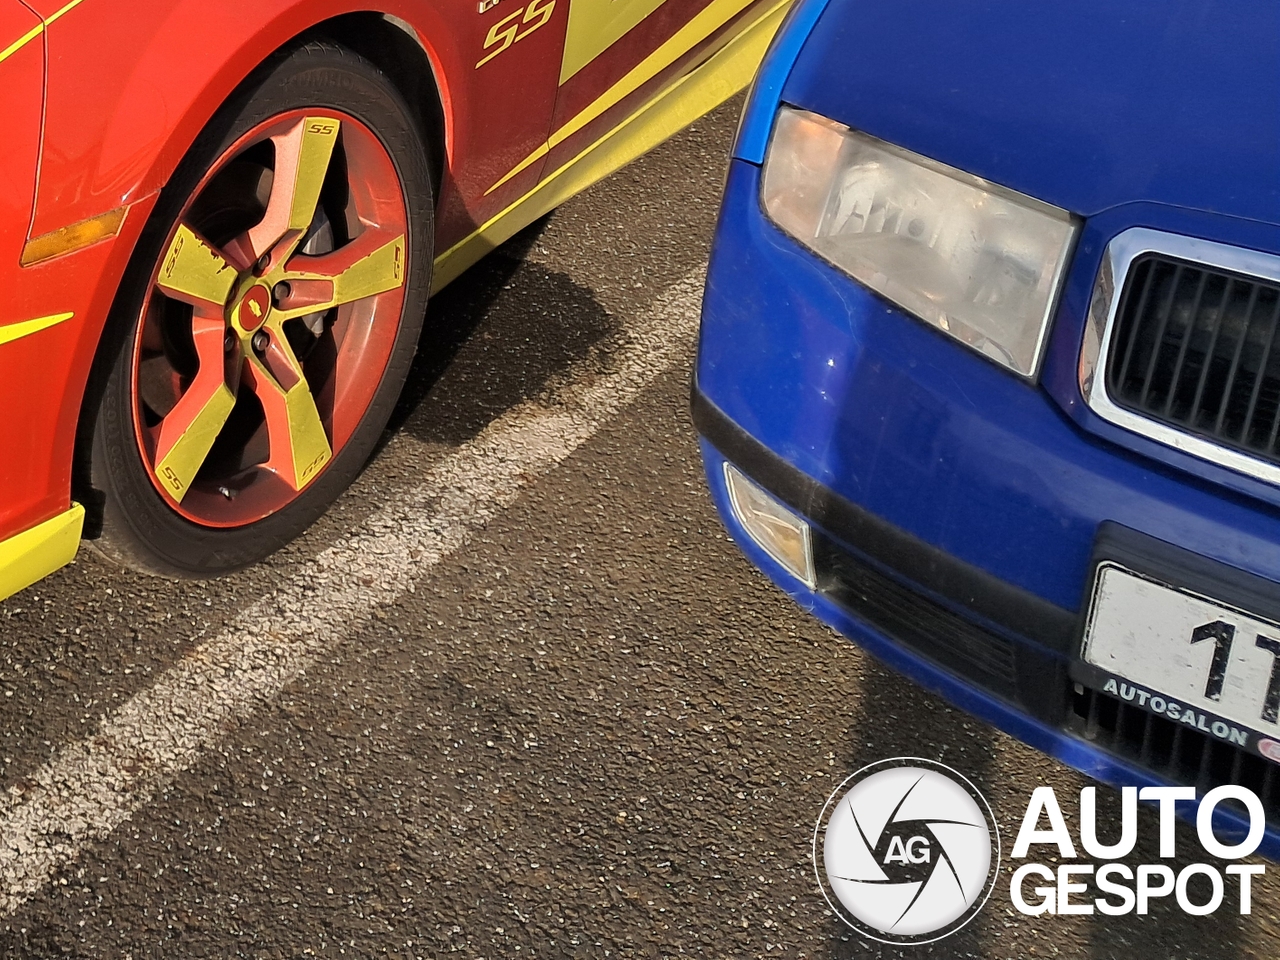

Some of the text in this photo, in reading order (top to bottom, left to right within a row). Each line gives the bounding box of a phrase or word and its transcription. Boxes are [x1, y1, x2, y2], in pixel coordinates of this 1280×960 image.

[307, 124, 335, 135] SS
[161, 466, 184, 491] SS
[1103, 677, 1250, 748] AUTOSALON
